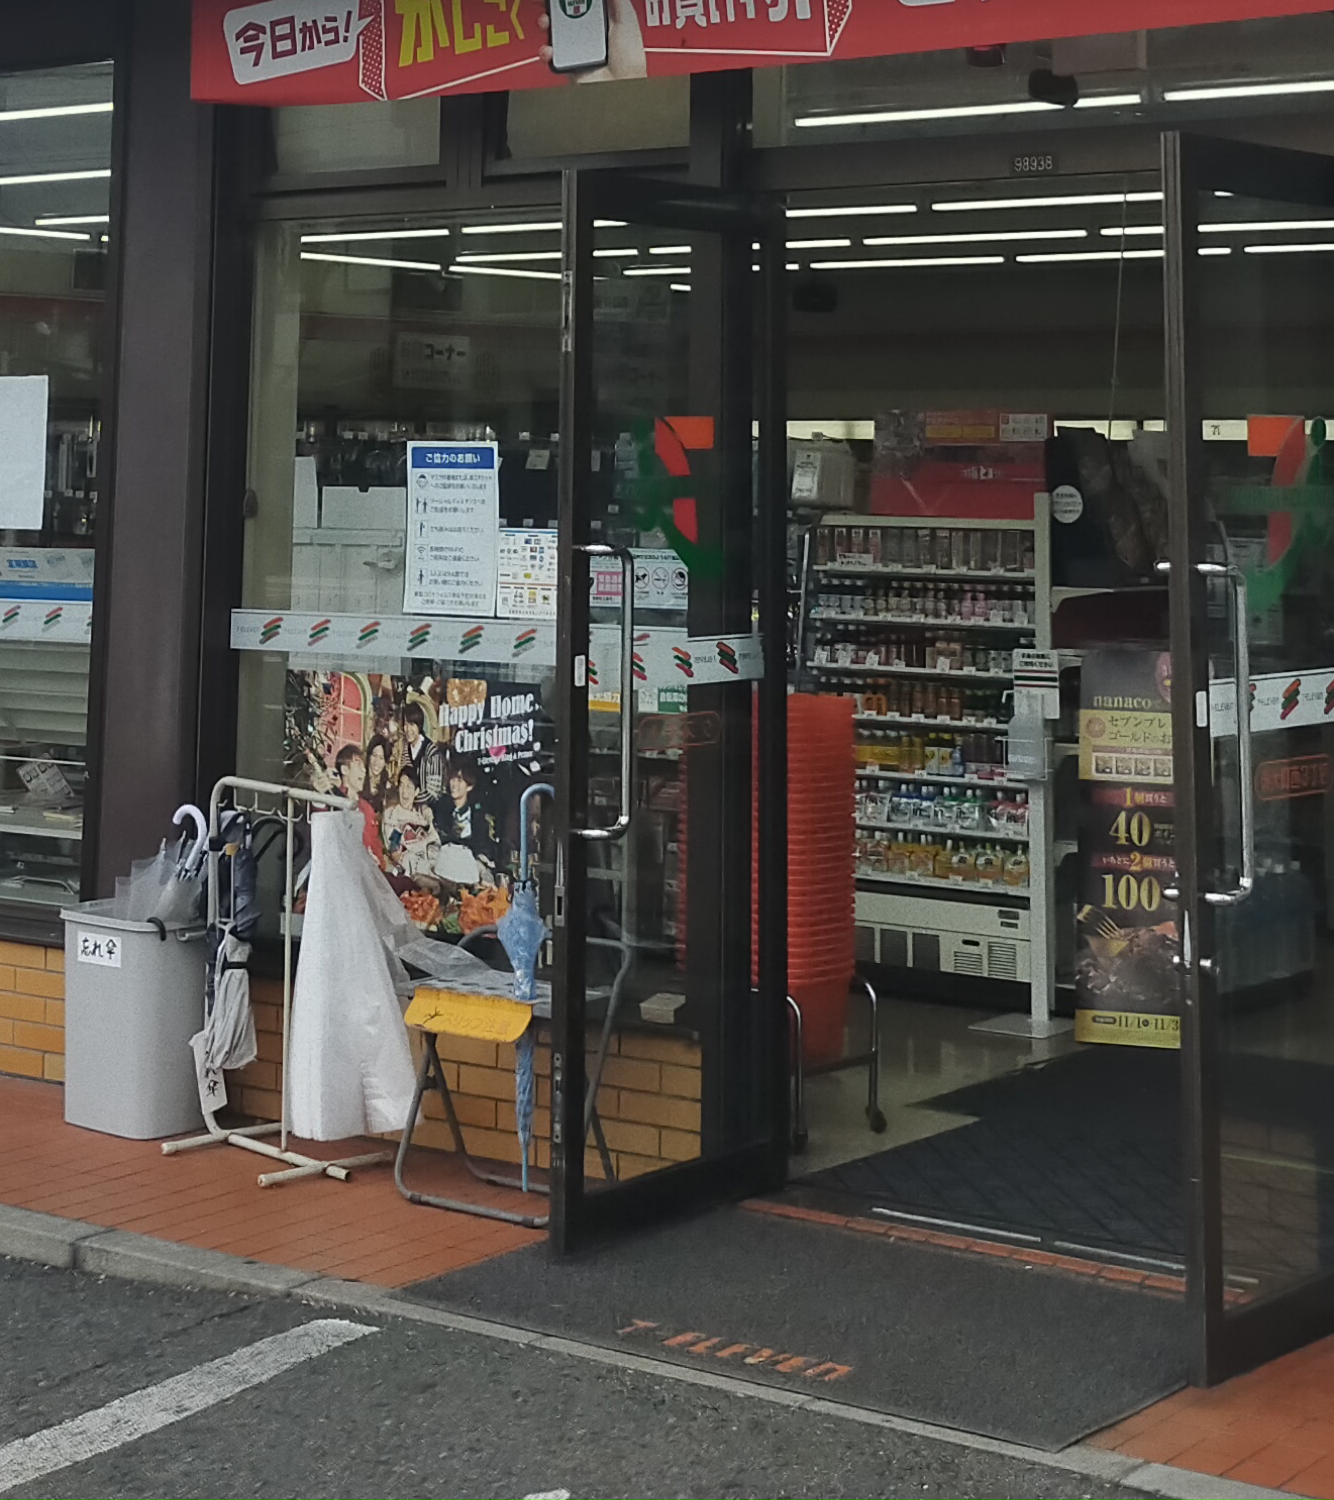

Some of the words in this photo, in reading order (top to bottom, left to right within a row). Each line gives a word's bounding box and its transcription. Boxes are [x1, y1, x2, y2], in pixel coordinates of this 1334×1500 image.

[438, 701, 486, 729] Happy
[1093, 695, 1152, 709] nanaco
[454, 718, 535, 754] Christmas!
[1108, 810, 1152, 848] 40
[1101, 873, 1162, 913] 100
